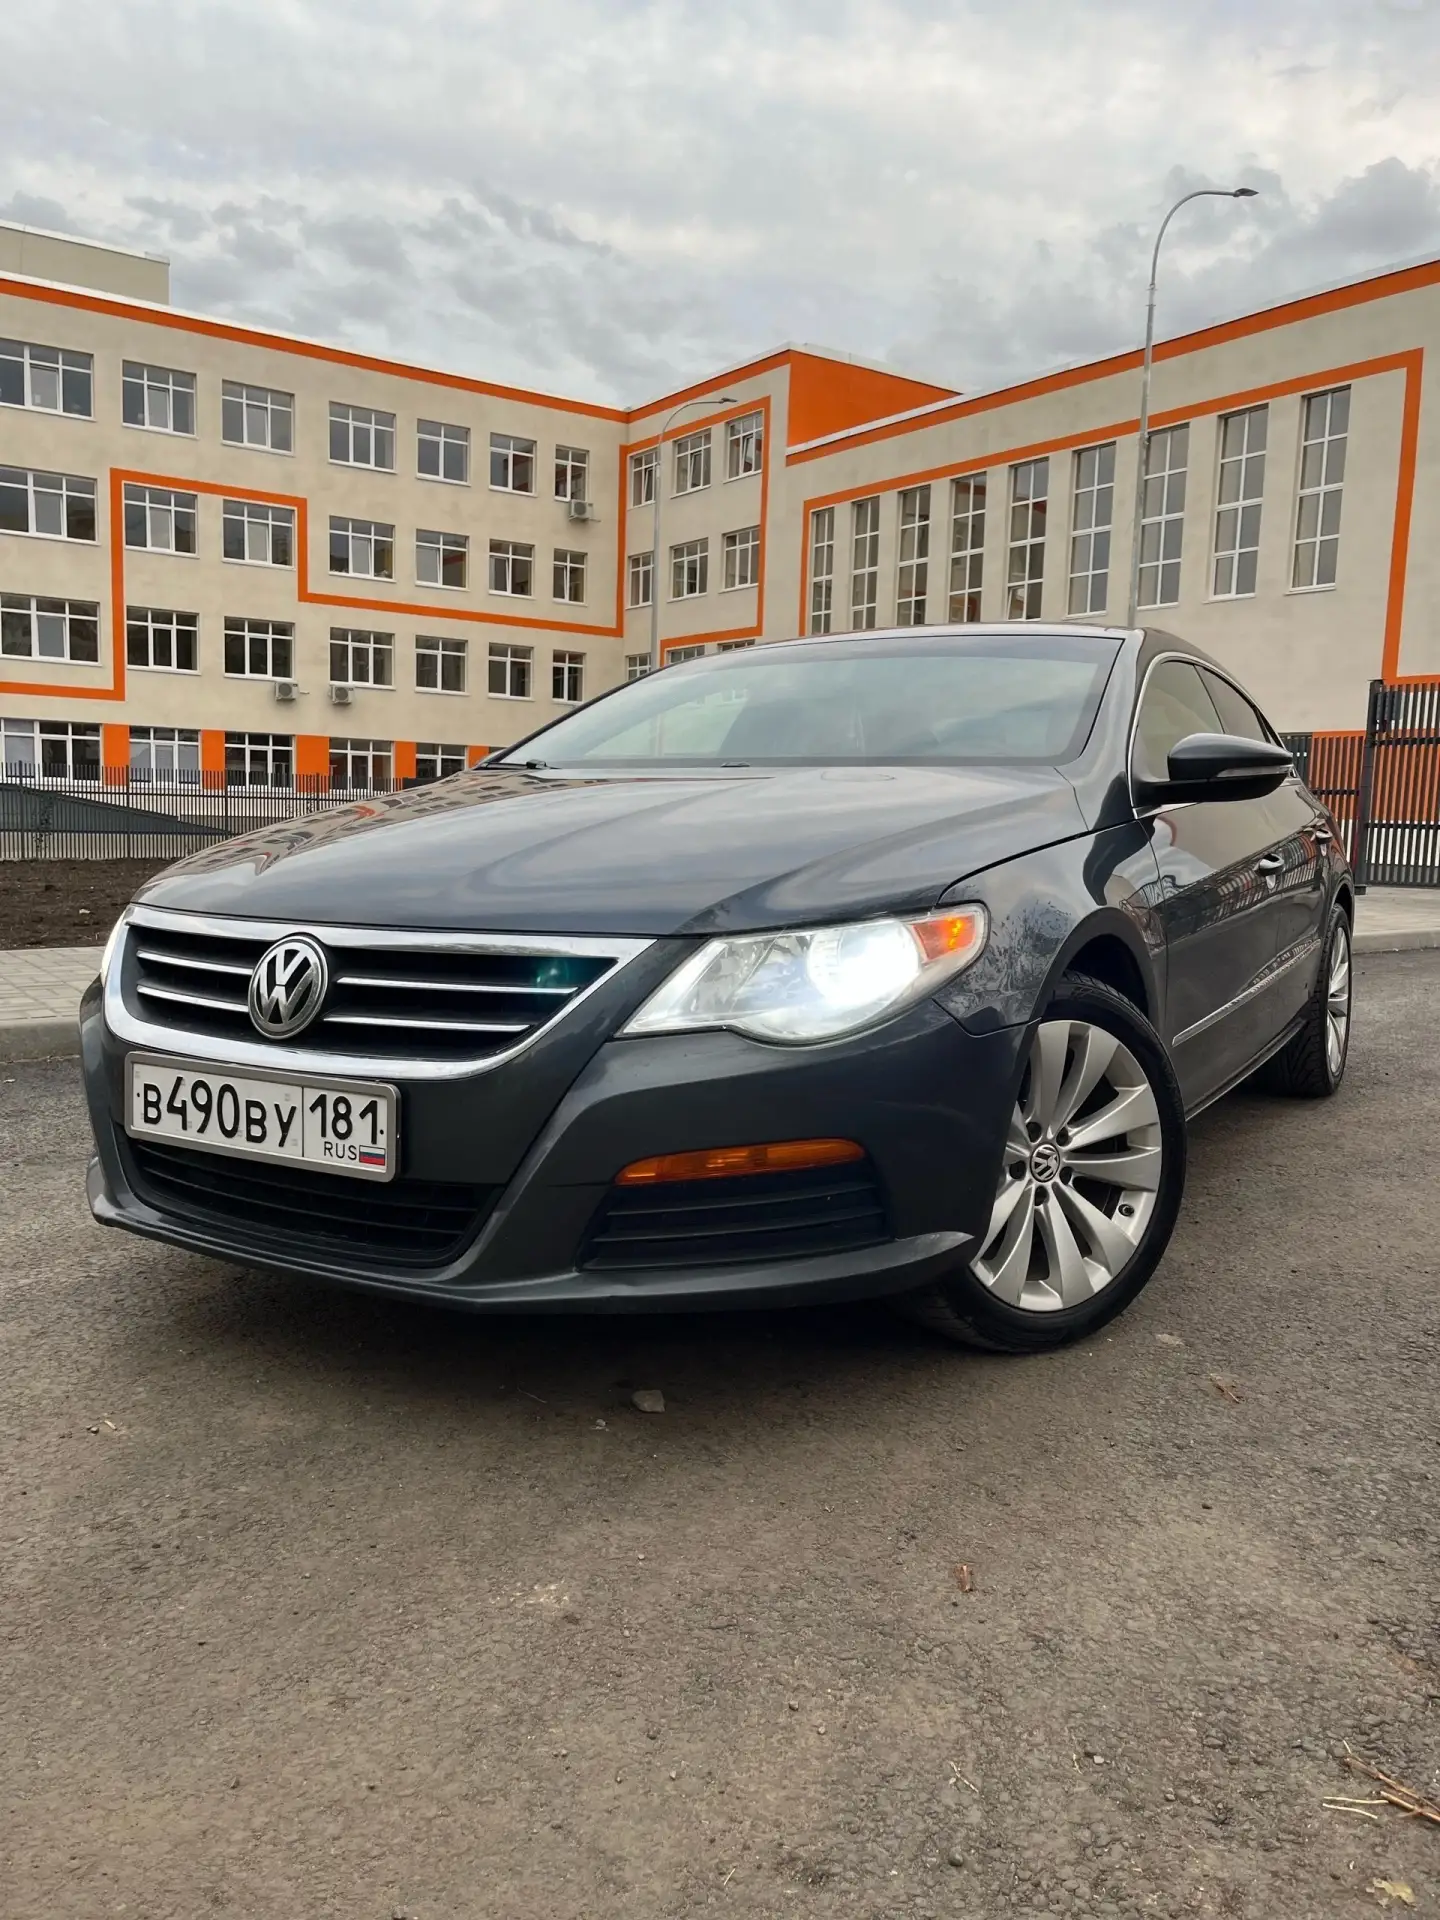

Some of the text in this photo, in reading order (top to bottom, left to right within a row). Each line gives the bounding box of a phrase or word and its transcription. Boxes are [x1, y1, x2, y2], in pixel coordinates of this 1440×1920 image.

[253, 941, 322, 1033] VW
[309, 1093, 378, 1145] 181
[323, 1141, 358, 1161] RUS
